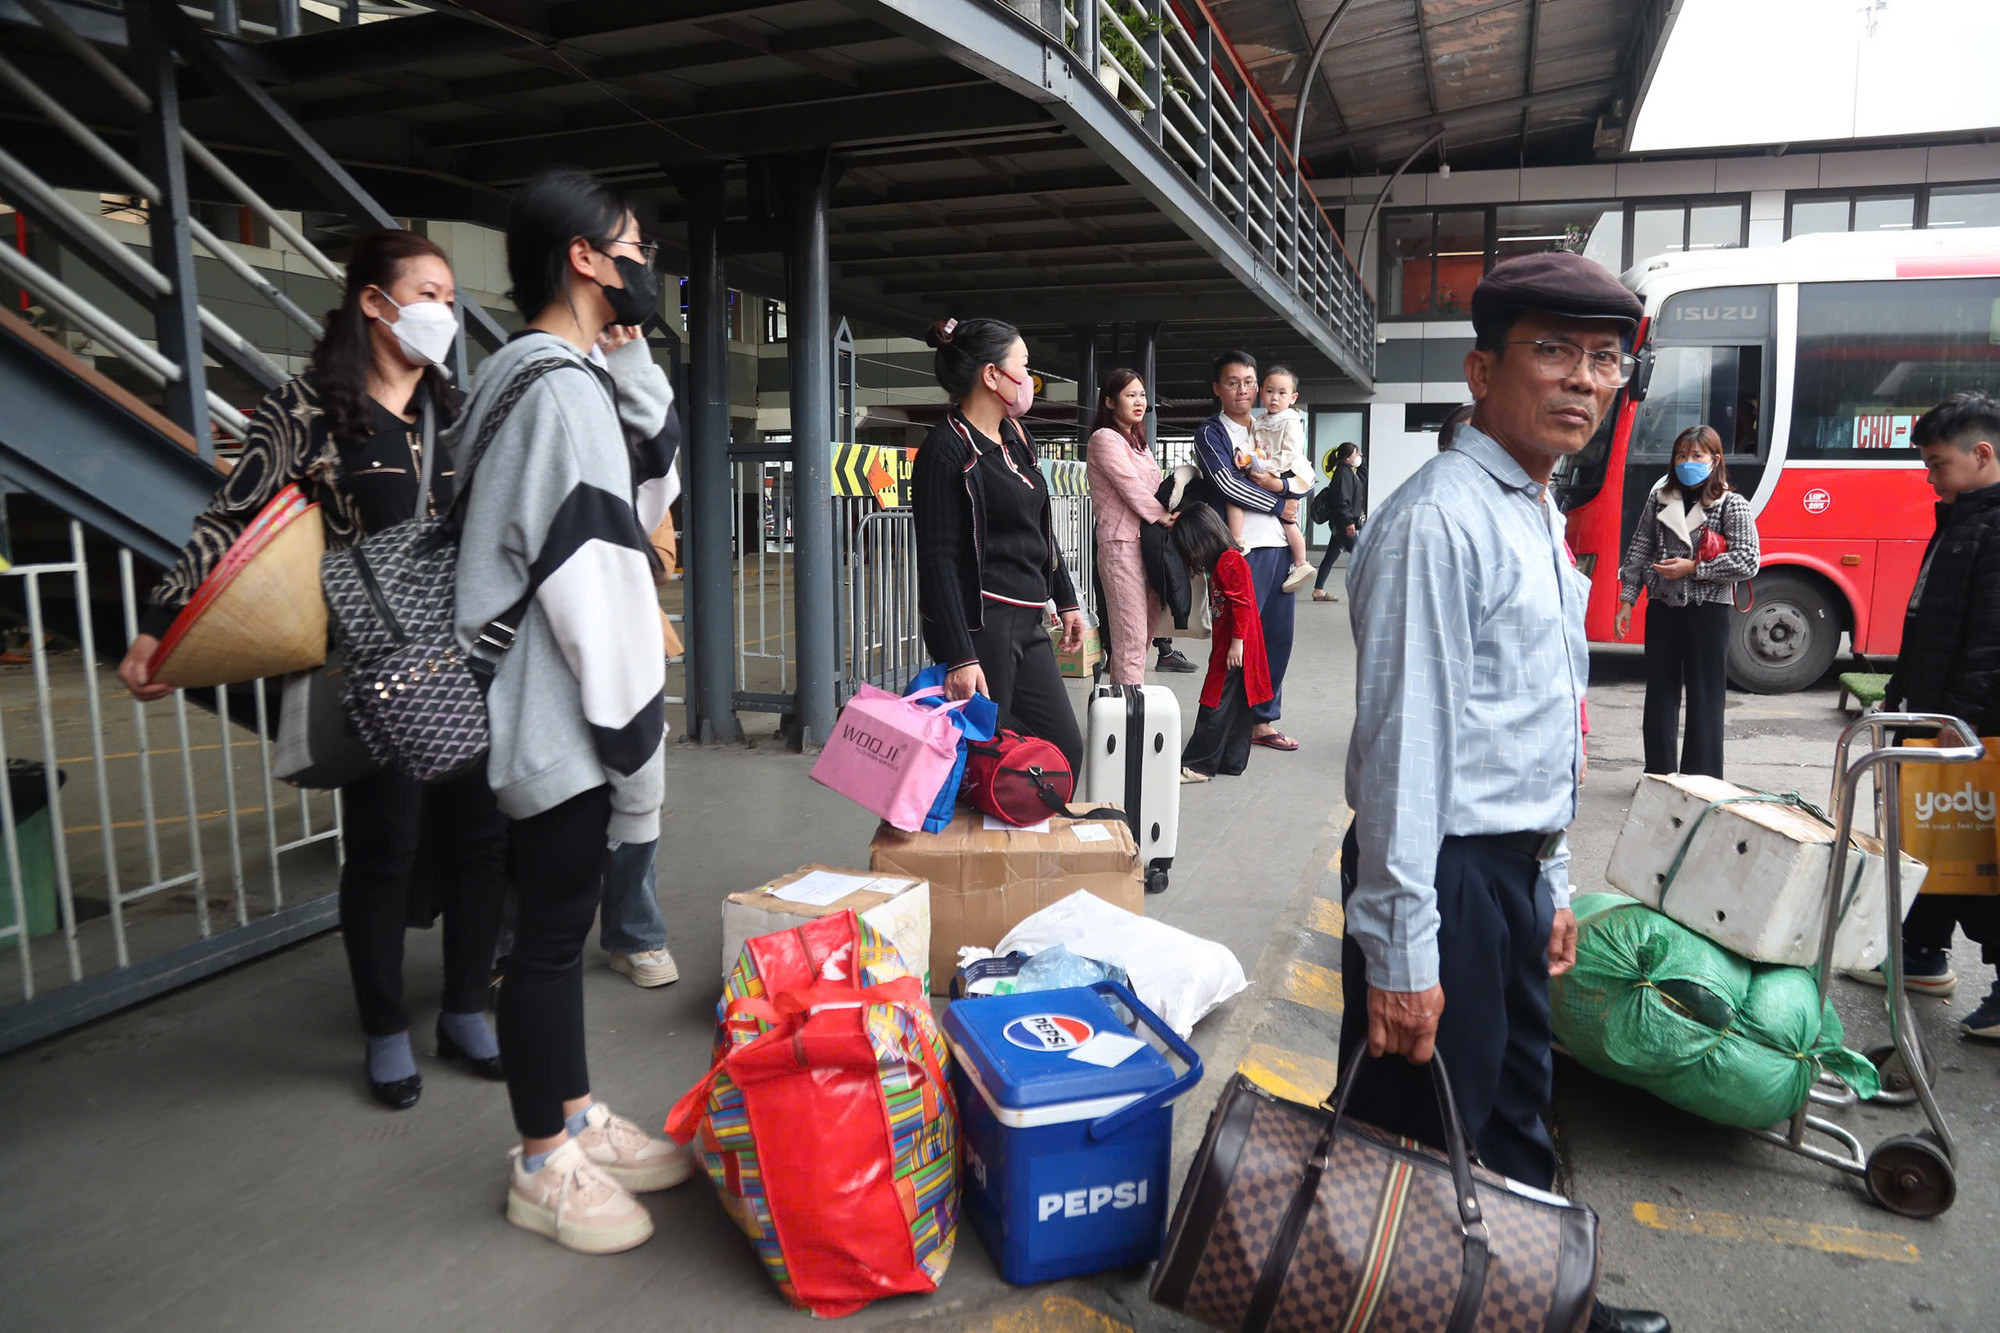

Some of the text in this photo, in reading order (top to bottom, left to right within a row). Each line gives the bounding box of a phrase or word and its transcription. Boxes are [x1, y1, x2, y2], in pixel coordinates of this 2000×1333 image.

[1676, 305, 1758, 321] ISUZU
[1915, 782, 1996, 821] yody
[1029, 1017, 1070, 1048] PEPSI
[1038, 1179, 1148, 1222] PEPSI
